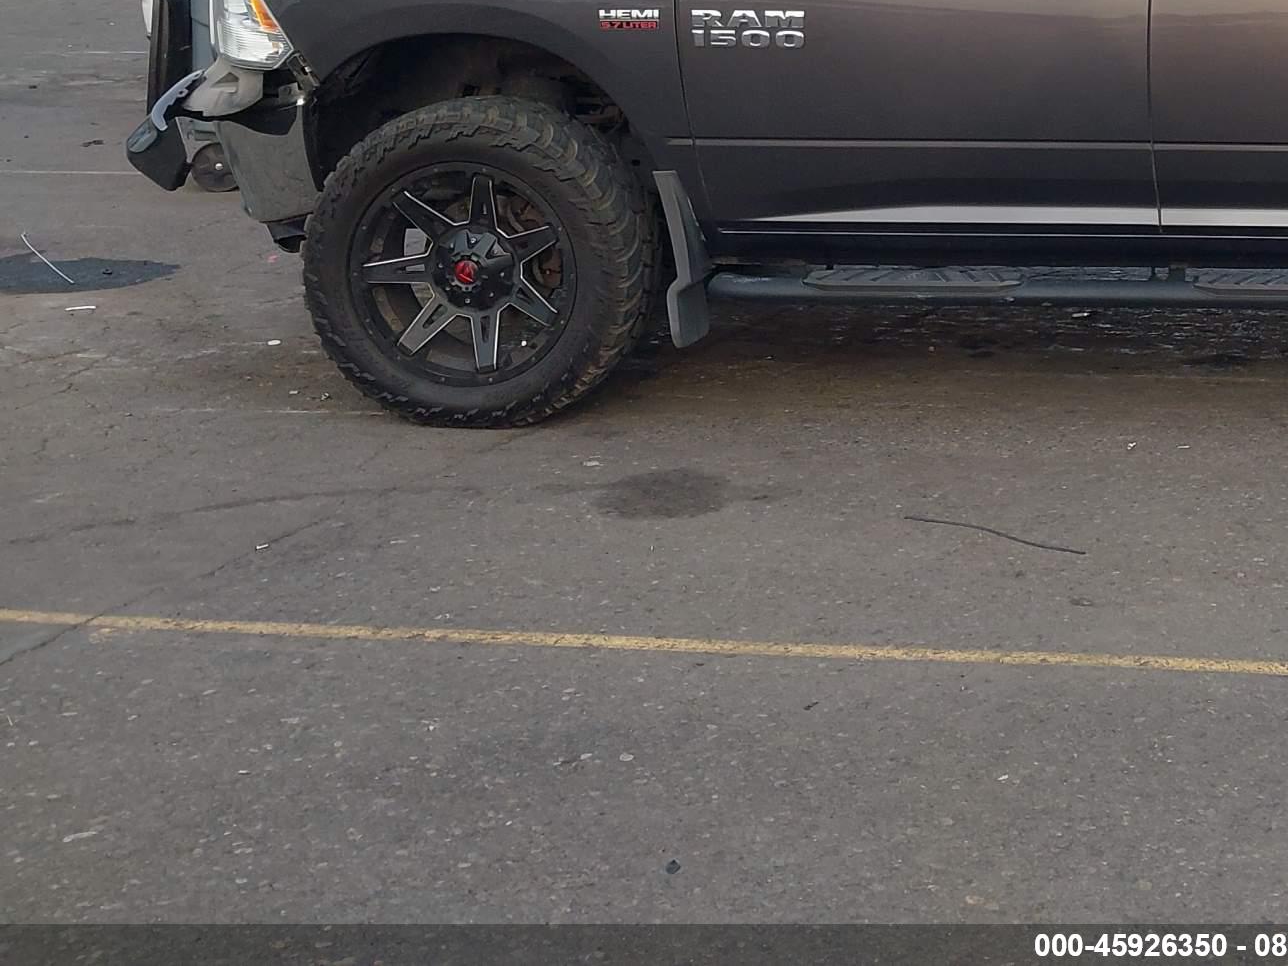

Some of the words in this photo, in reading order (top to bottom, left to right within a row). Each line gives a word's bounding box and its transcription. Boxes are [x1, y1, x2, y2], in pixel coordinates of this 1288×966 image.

[599, 9, 660, 20] HEMI
[691, 9, 805, 28] RAM
[600, 20, 621, 30] 5.7
[624, 20, 658, 30] LITER
[691, 29, 805, 48] 1500
